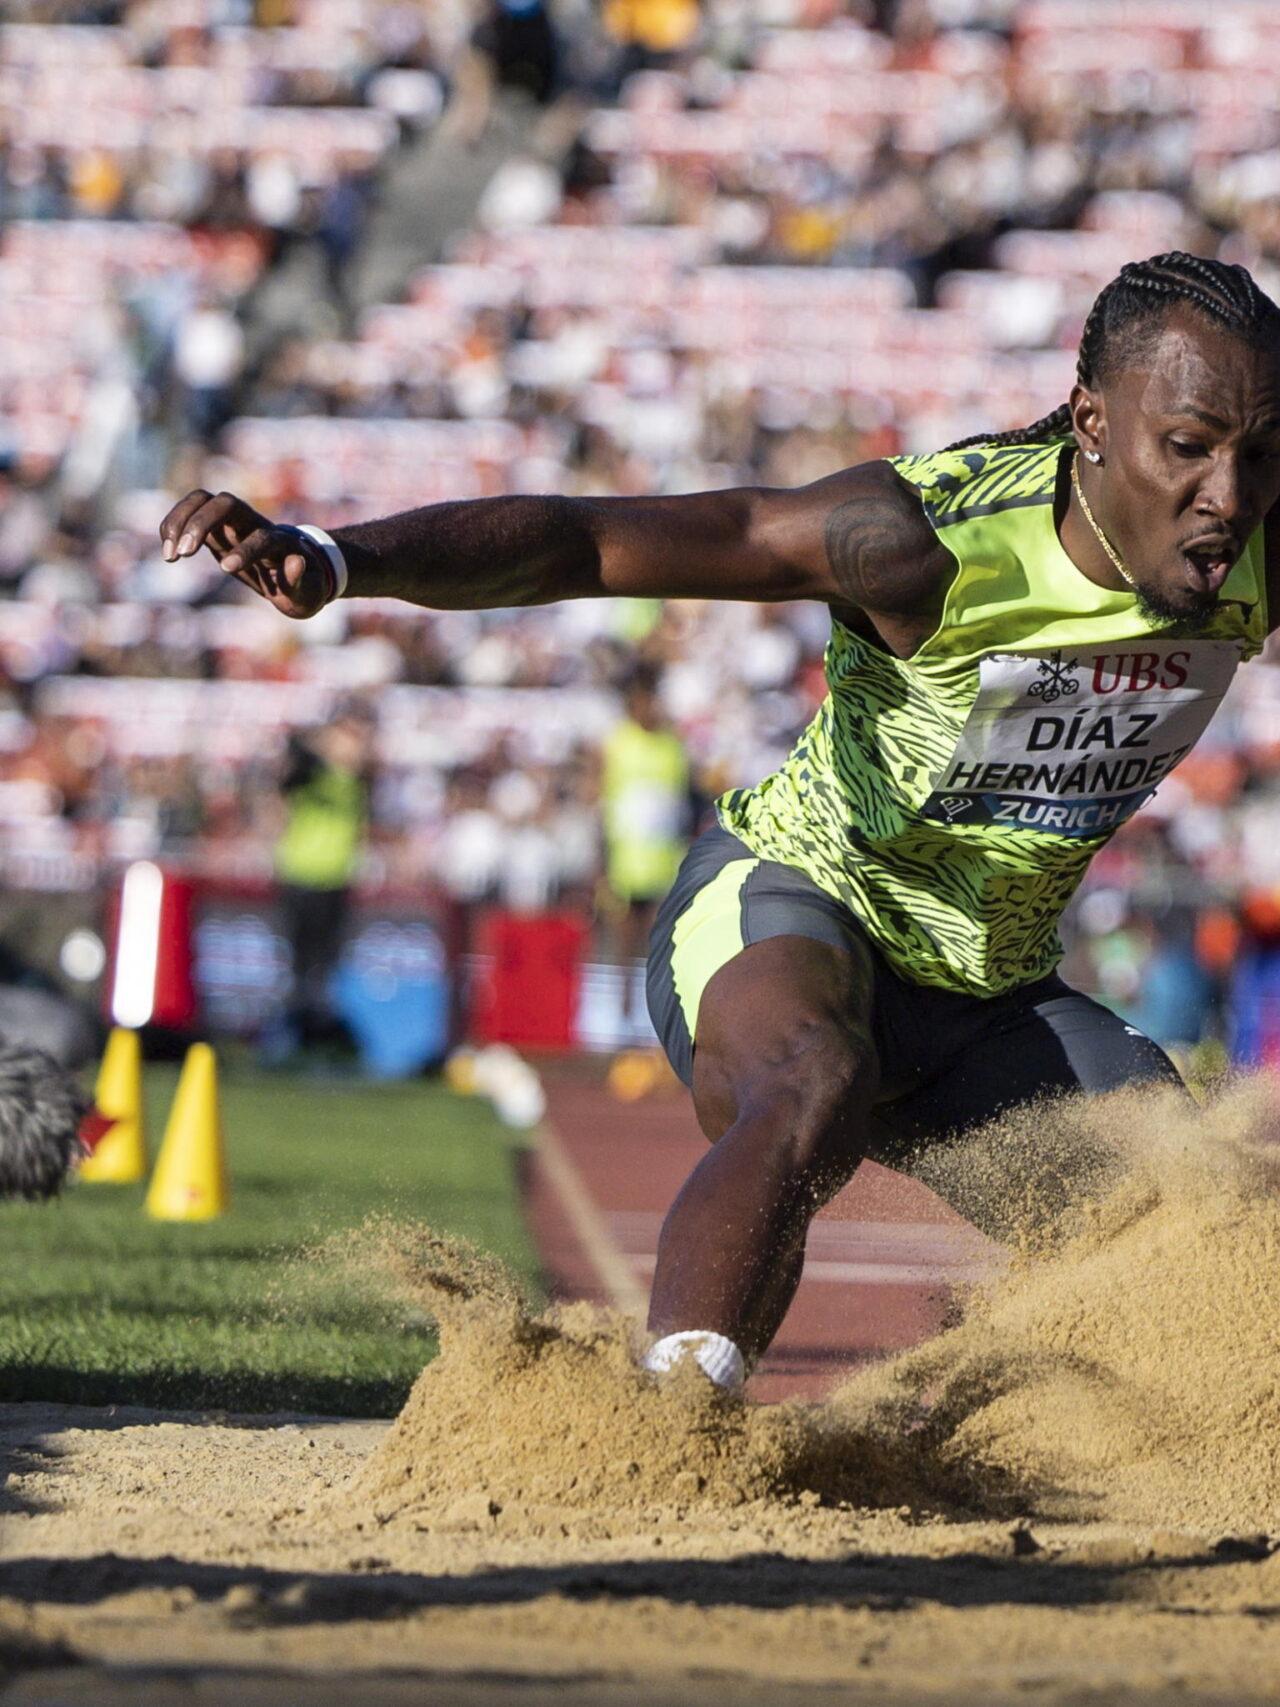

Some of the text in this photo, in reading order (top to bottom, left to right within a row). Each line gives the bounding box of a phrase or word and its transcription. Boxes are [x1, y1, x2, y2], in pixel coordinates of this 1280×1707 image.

[1092, 652, 1191, 694] UBS
[1026, 708, 1158, 751] DÍAZ
[993, 801, 1121, 829] ZURICH
